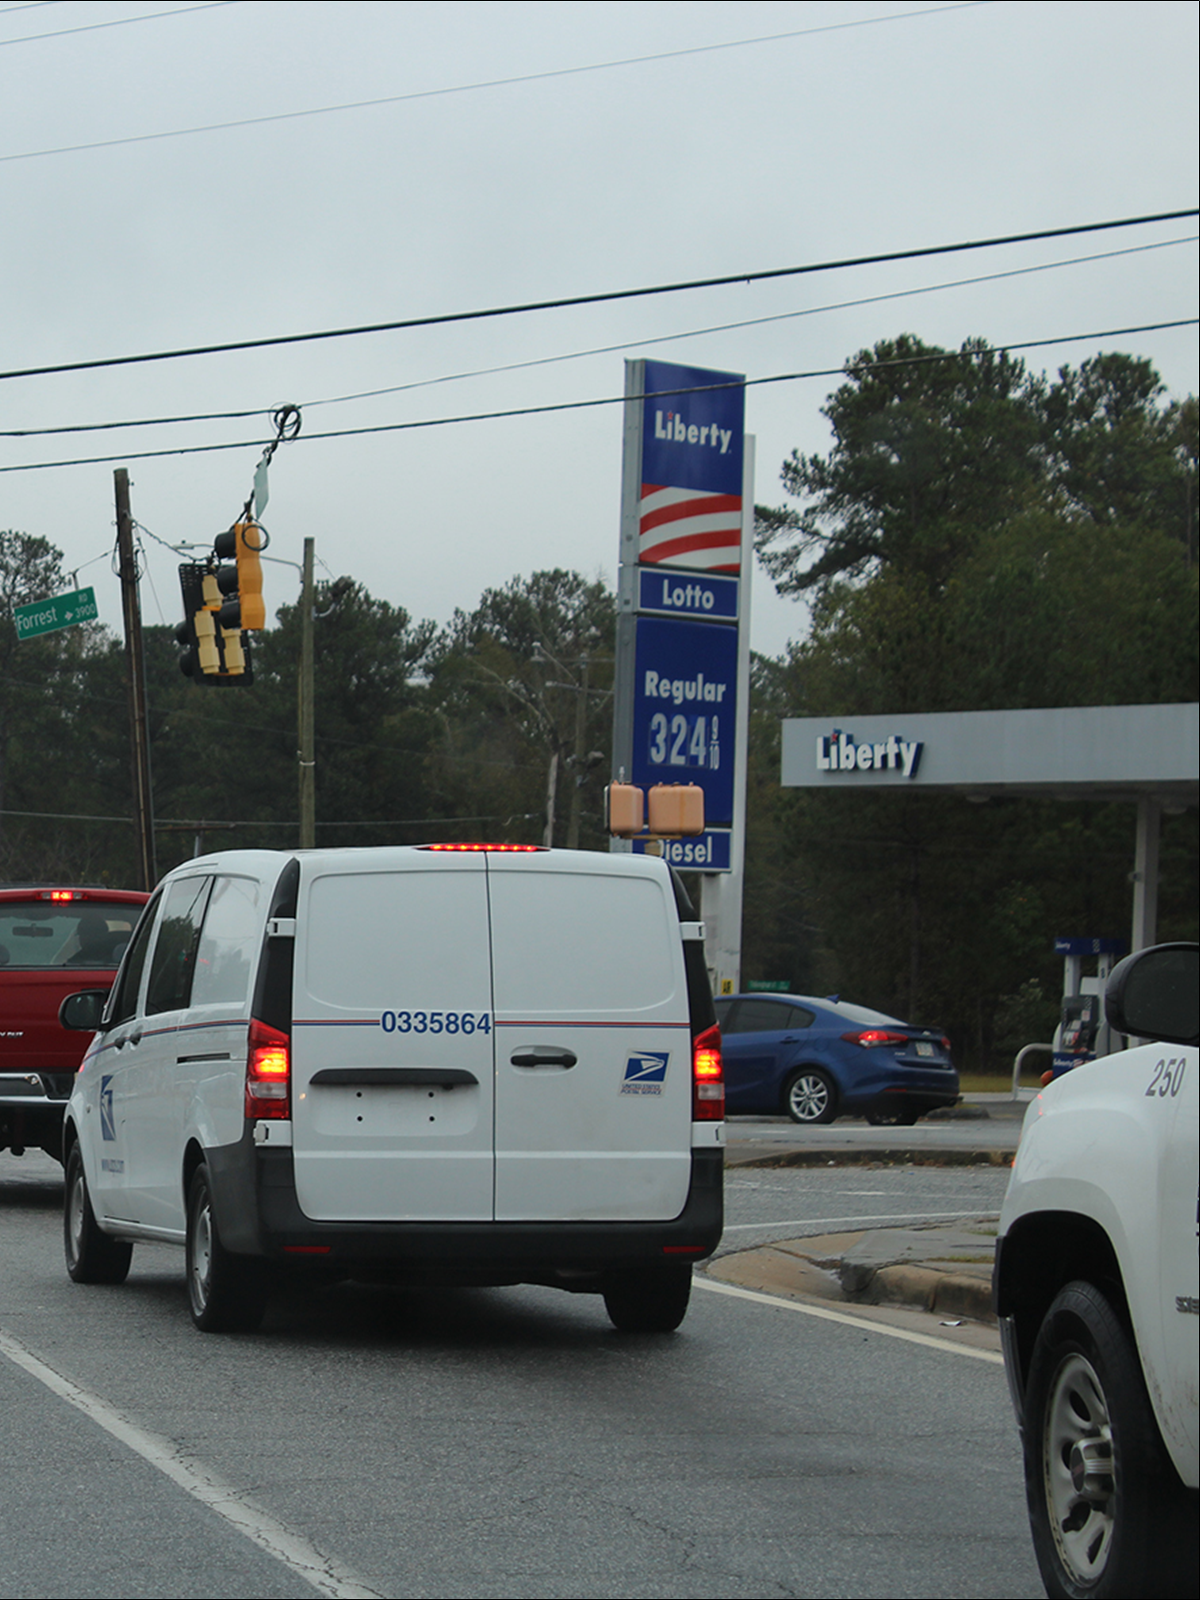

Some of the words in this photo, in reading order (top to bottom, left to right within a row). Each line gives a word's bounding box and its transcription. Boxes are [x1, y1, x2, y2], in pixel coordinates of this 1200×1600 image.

[654, 410, 732, 454] Liberty
[662, 579, 714, 609] Lotto
[16, 606, 58, 631] Forrest
[645, 670, 726, 704] Regular
[815, 728, 922, 777] Liberty
[381, 1010, 492, 1035] 0335864
[1145, 1057, 1187, 1098] 250
